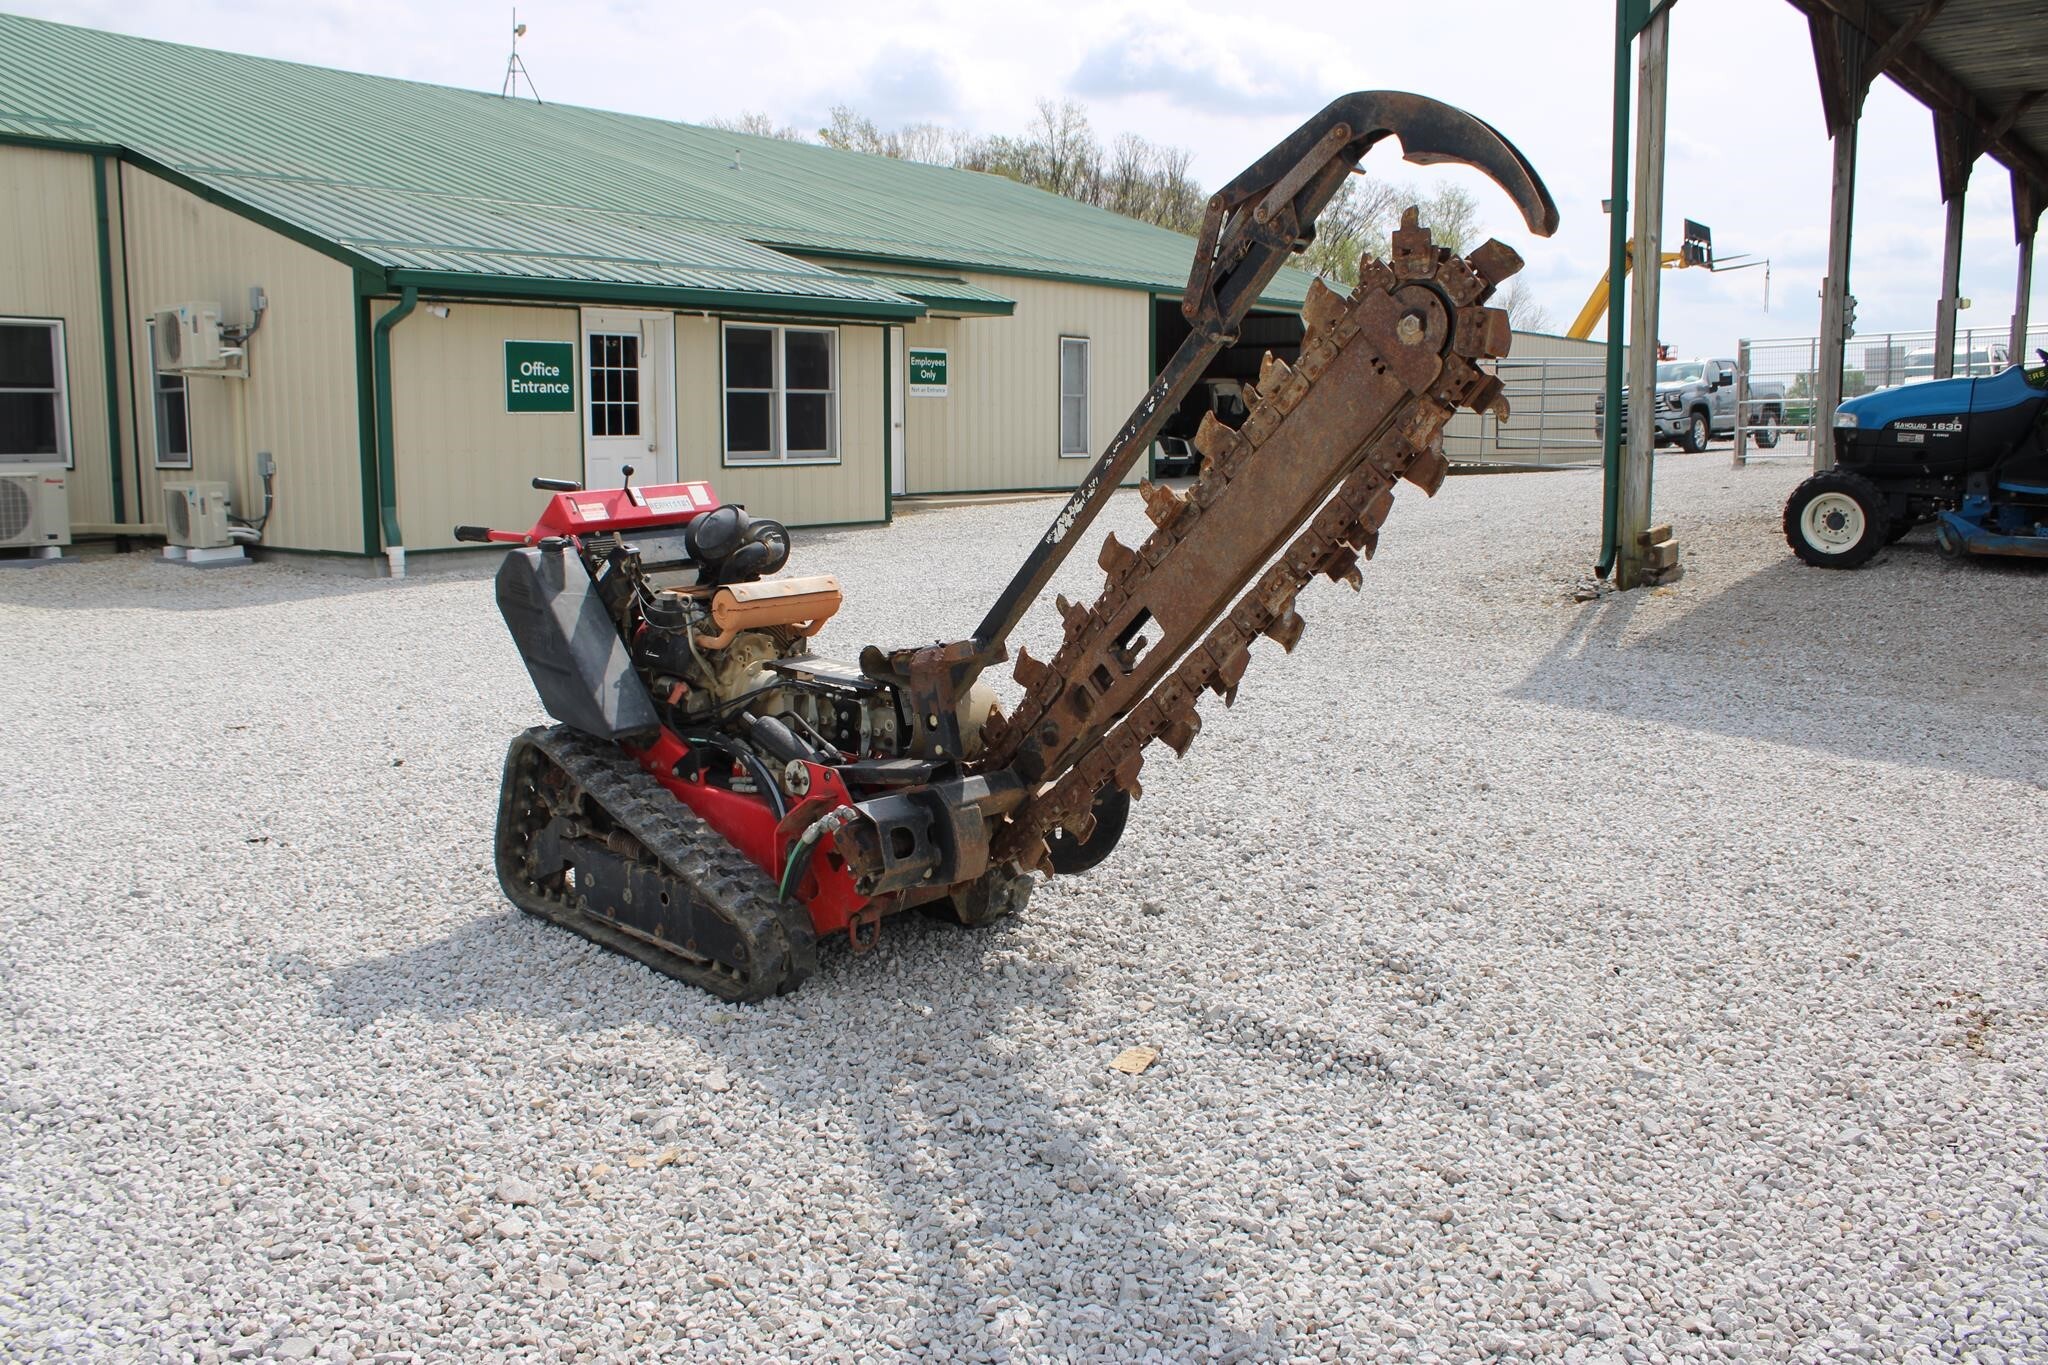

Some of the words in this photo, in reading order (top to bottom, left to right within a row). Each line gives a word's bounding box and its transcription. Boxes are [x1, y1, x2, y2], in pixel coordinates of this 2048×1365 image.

[520, 361, 560, 377] Office
[910, 356, 946, 369] Employees
[920, 369, 937, 382] Only
[511, 378, 570, 394] Entrance
[1931, 422, 1963, 431] 1630
